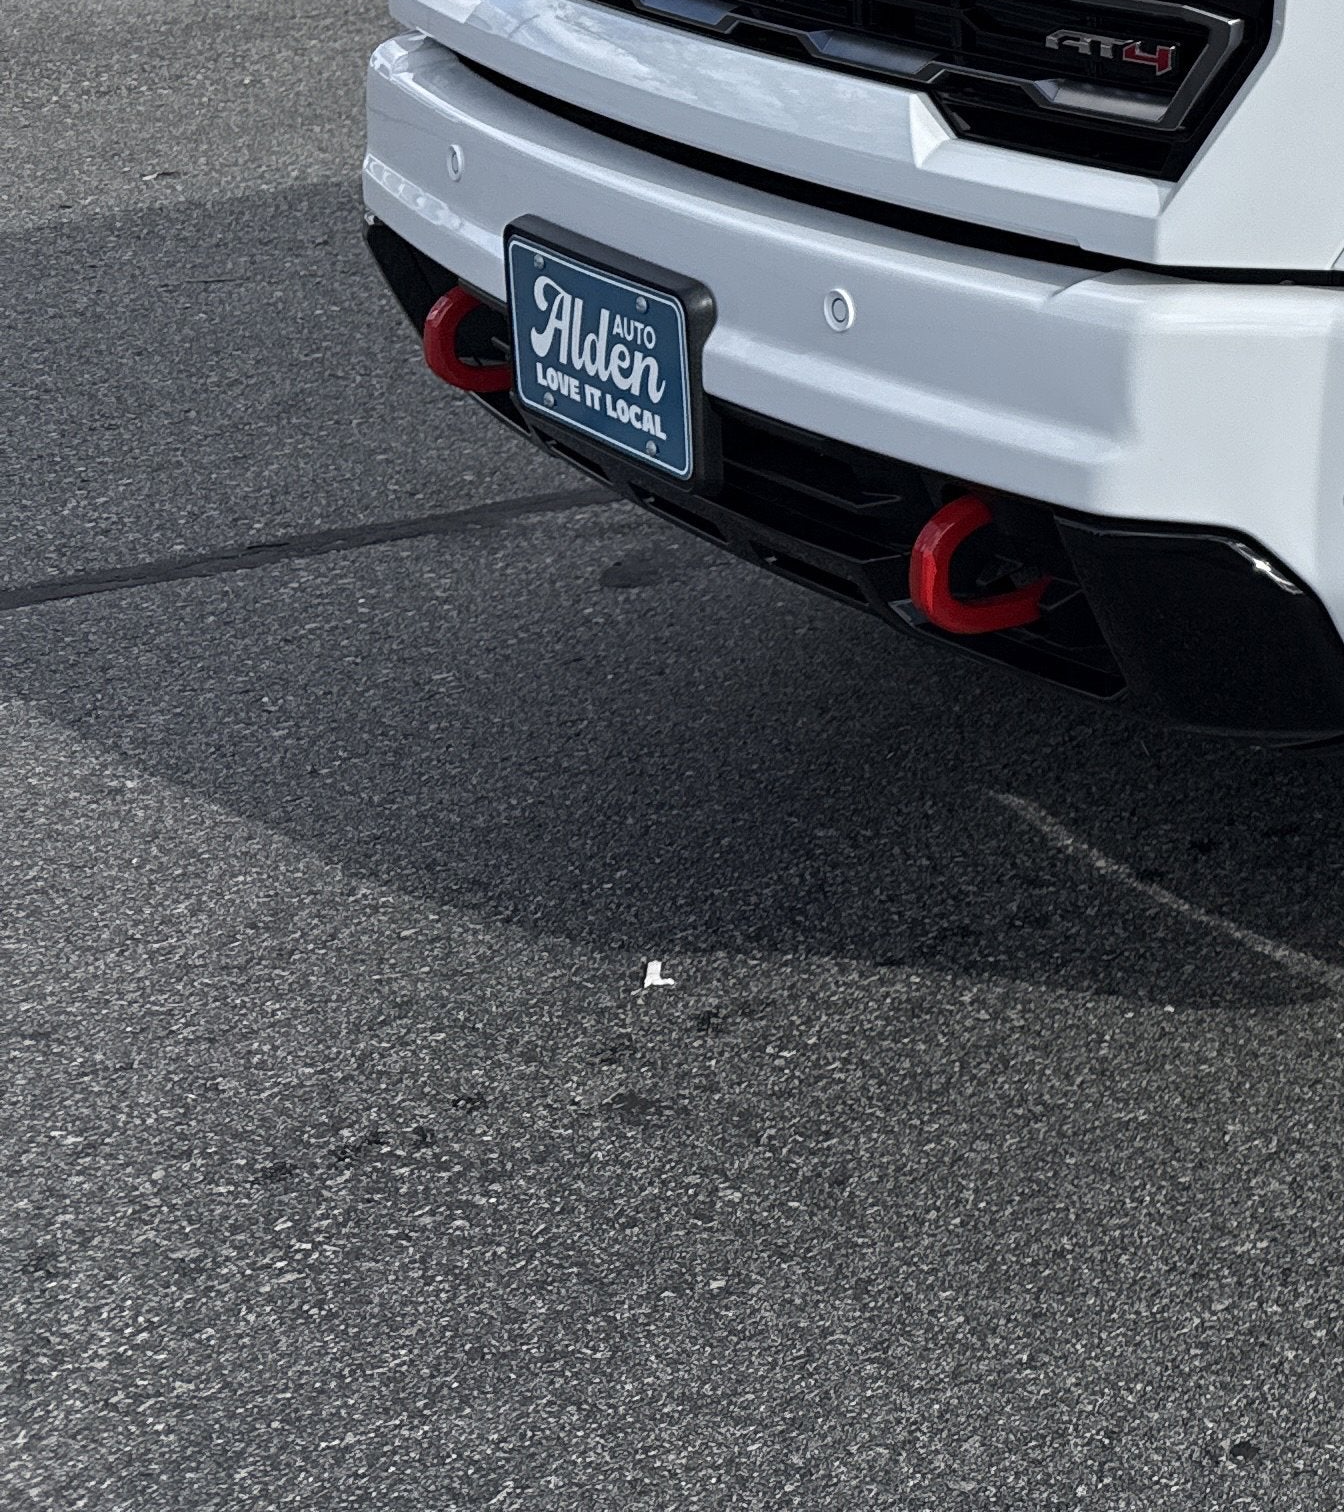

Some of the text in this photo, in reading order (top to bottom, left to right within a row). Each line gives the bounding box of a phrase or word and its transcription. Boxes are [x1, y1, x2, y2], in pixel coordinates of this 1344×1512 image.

[1045, 29, 1177, 76] AT4
[530, 275, 666, 404] Alden
[612, 314, 656, 349] AUTO
[536, 361, 667, 440] LOVE IT LOCAL
